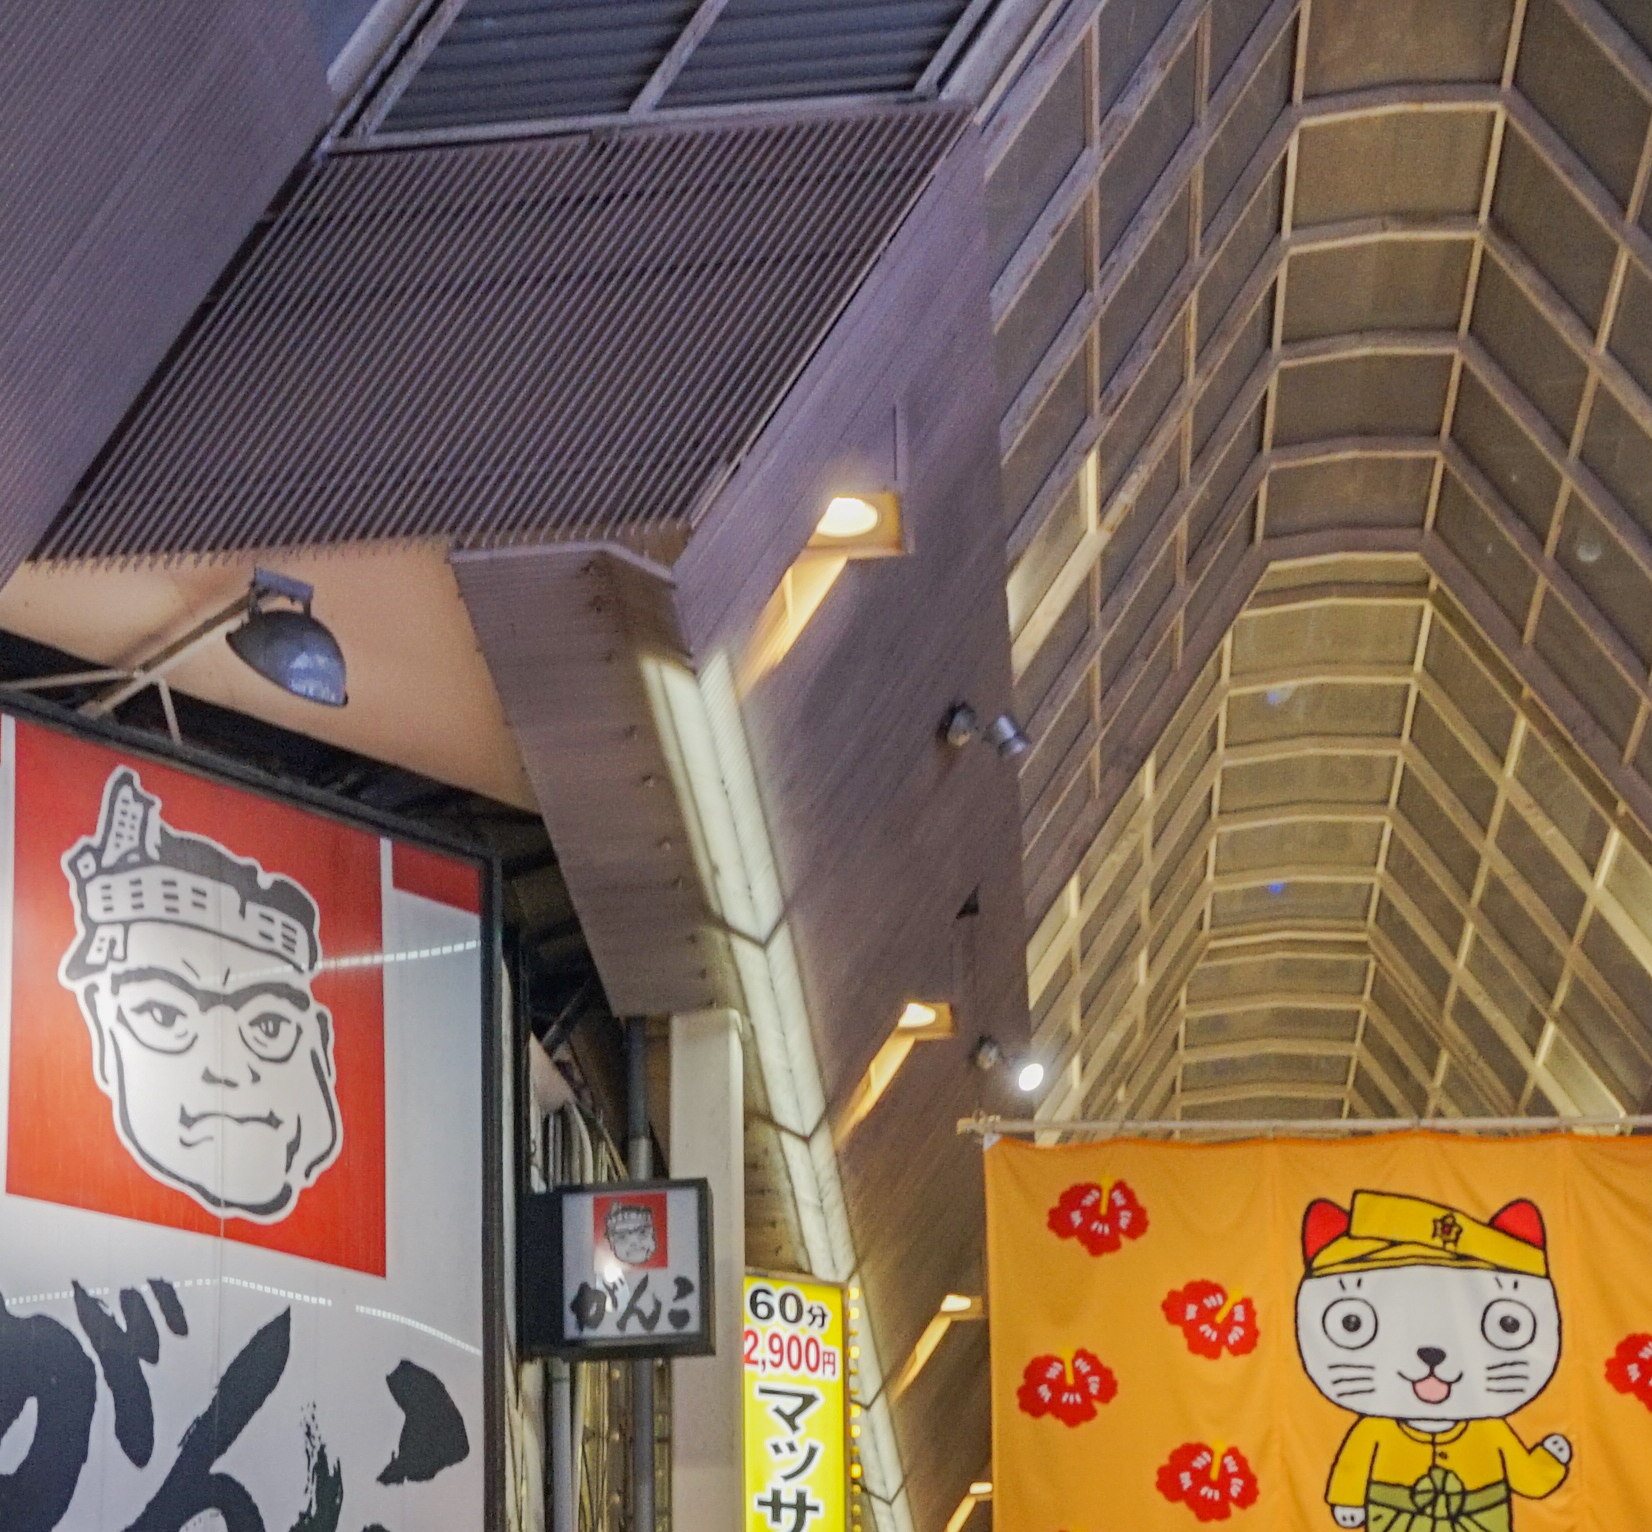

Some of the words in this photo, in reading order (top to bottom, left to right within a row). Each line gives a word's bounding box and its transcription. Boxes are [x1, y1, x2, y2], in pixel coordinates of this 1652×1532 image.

[570, 1274, 695, 1332] がんこ
[748, 1288, 829, 1329] 60分
[743, 1329, 838, 1378] 2,900円
